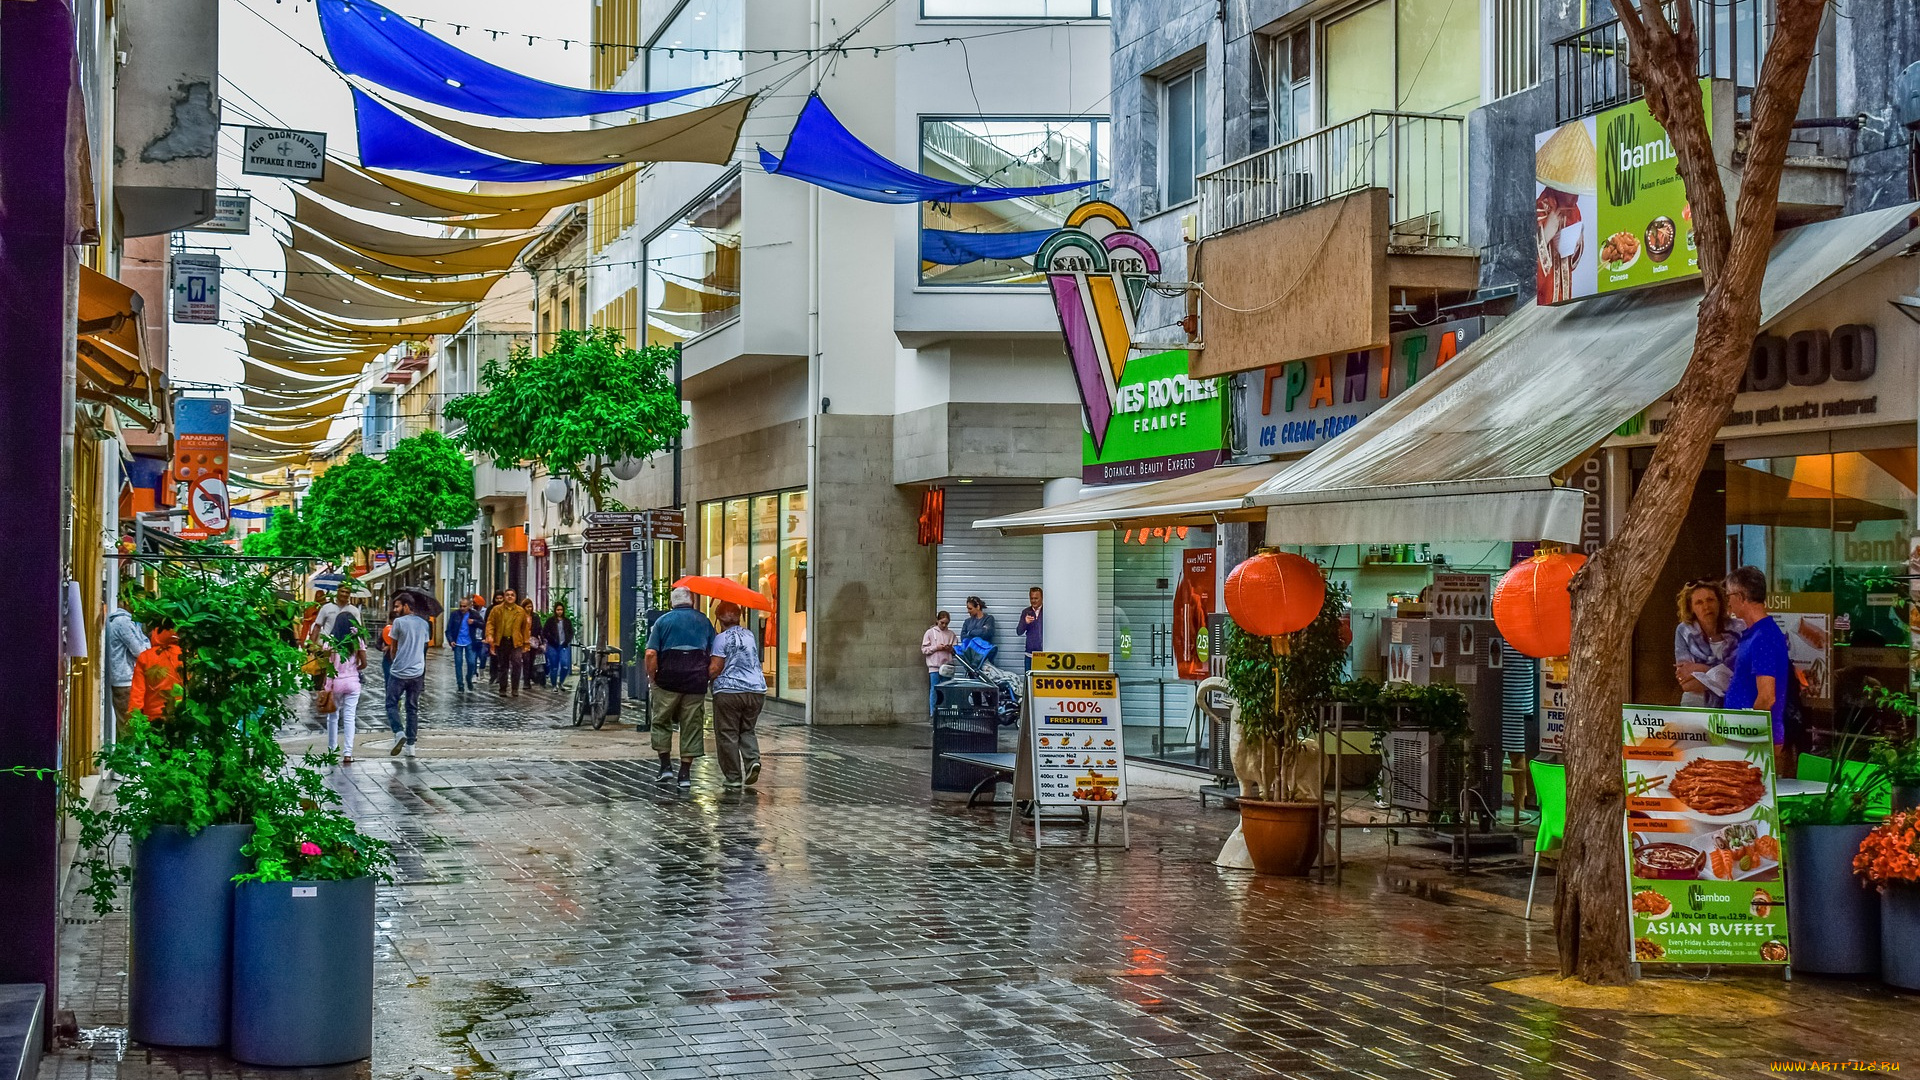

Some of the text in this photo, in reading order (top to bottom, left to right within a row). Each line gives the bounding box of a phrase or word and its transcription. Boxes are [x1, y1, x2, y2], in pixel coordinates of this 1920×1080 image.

[1641, 181, 1656, 191] Asian
[1656, 176, 1675, 187] Fusion
[1609, 273, 1629, 283] Chinese
[1115, 373, 1219, 414] VES ROCHER
[1133, 411, 1187, 433] FRANCE
[1259, 425, 1277, 447] ICE
[433, 534, 466, 544] Milano
[1197, 553, 1212, 563] MATTE
[1046, 653, 1076, 670] 30
[1035, 679, 1113, 690] SMOOTHIES
[1056, 700, 1102, 713] 100%
[1633, 713, 1666, 727] Asian
[1646, 727, 1708, 742] Restaurant
[1716, 723, 1759, 736] bamboo
[1694, 893, 1731, 903] bamboo
[1645, 921, 1776, 936] ASIAN BUFFET
[1668, 939, 1684, 947] Every
[1684, 939, 1701, 947] Friday
[1684, 948, 1708, 956] Saturday
